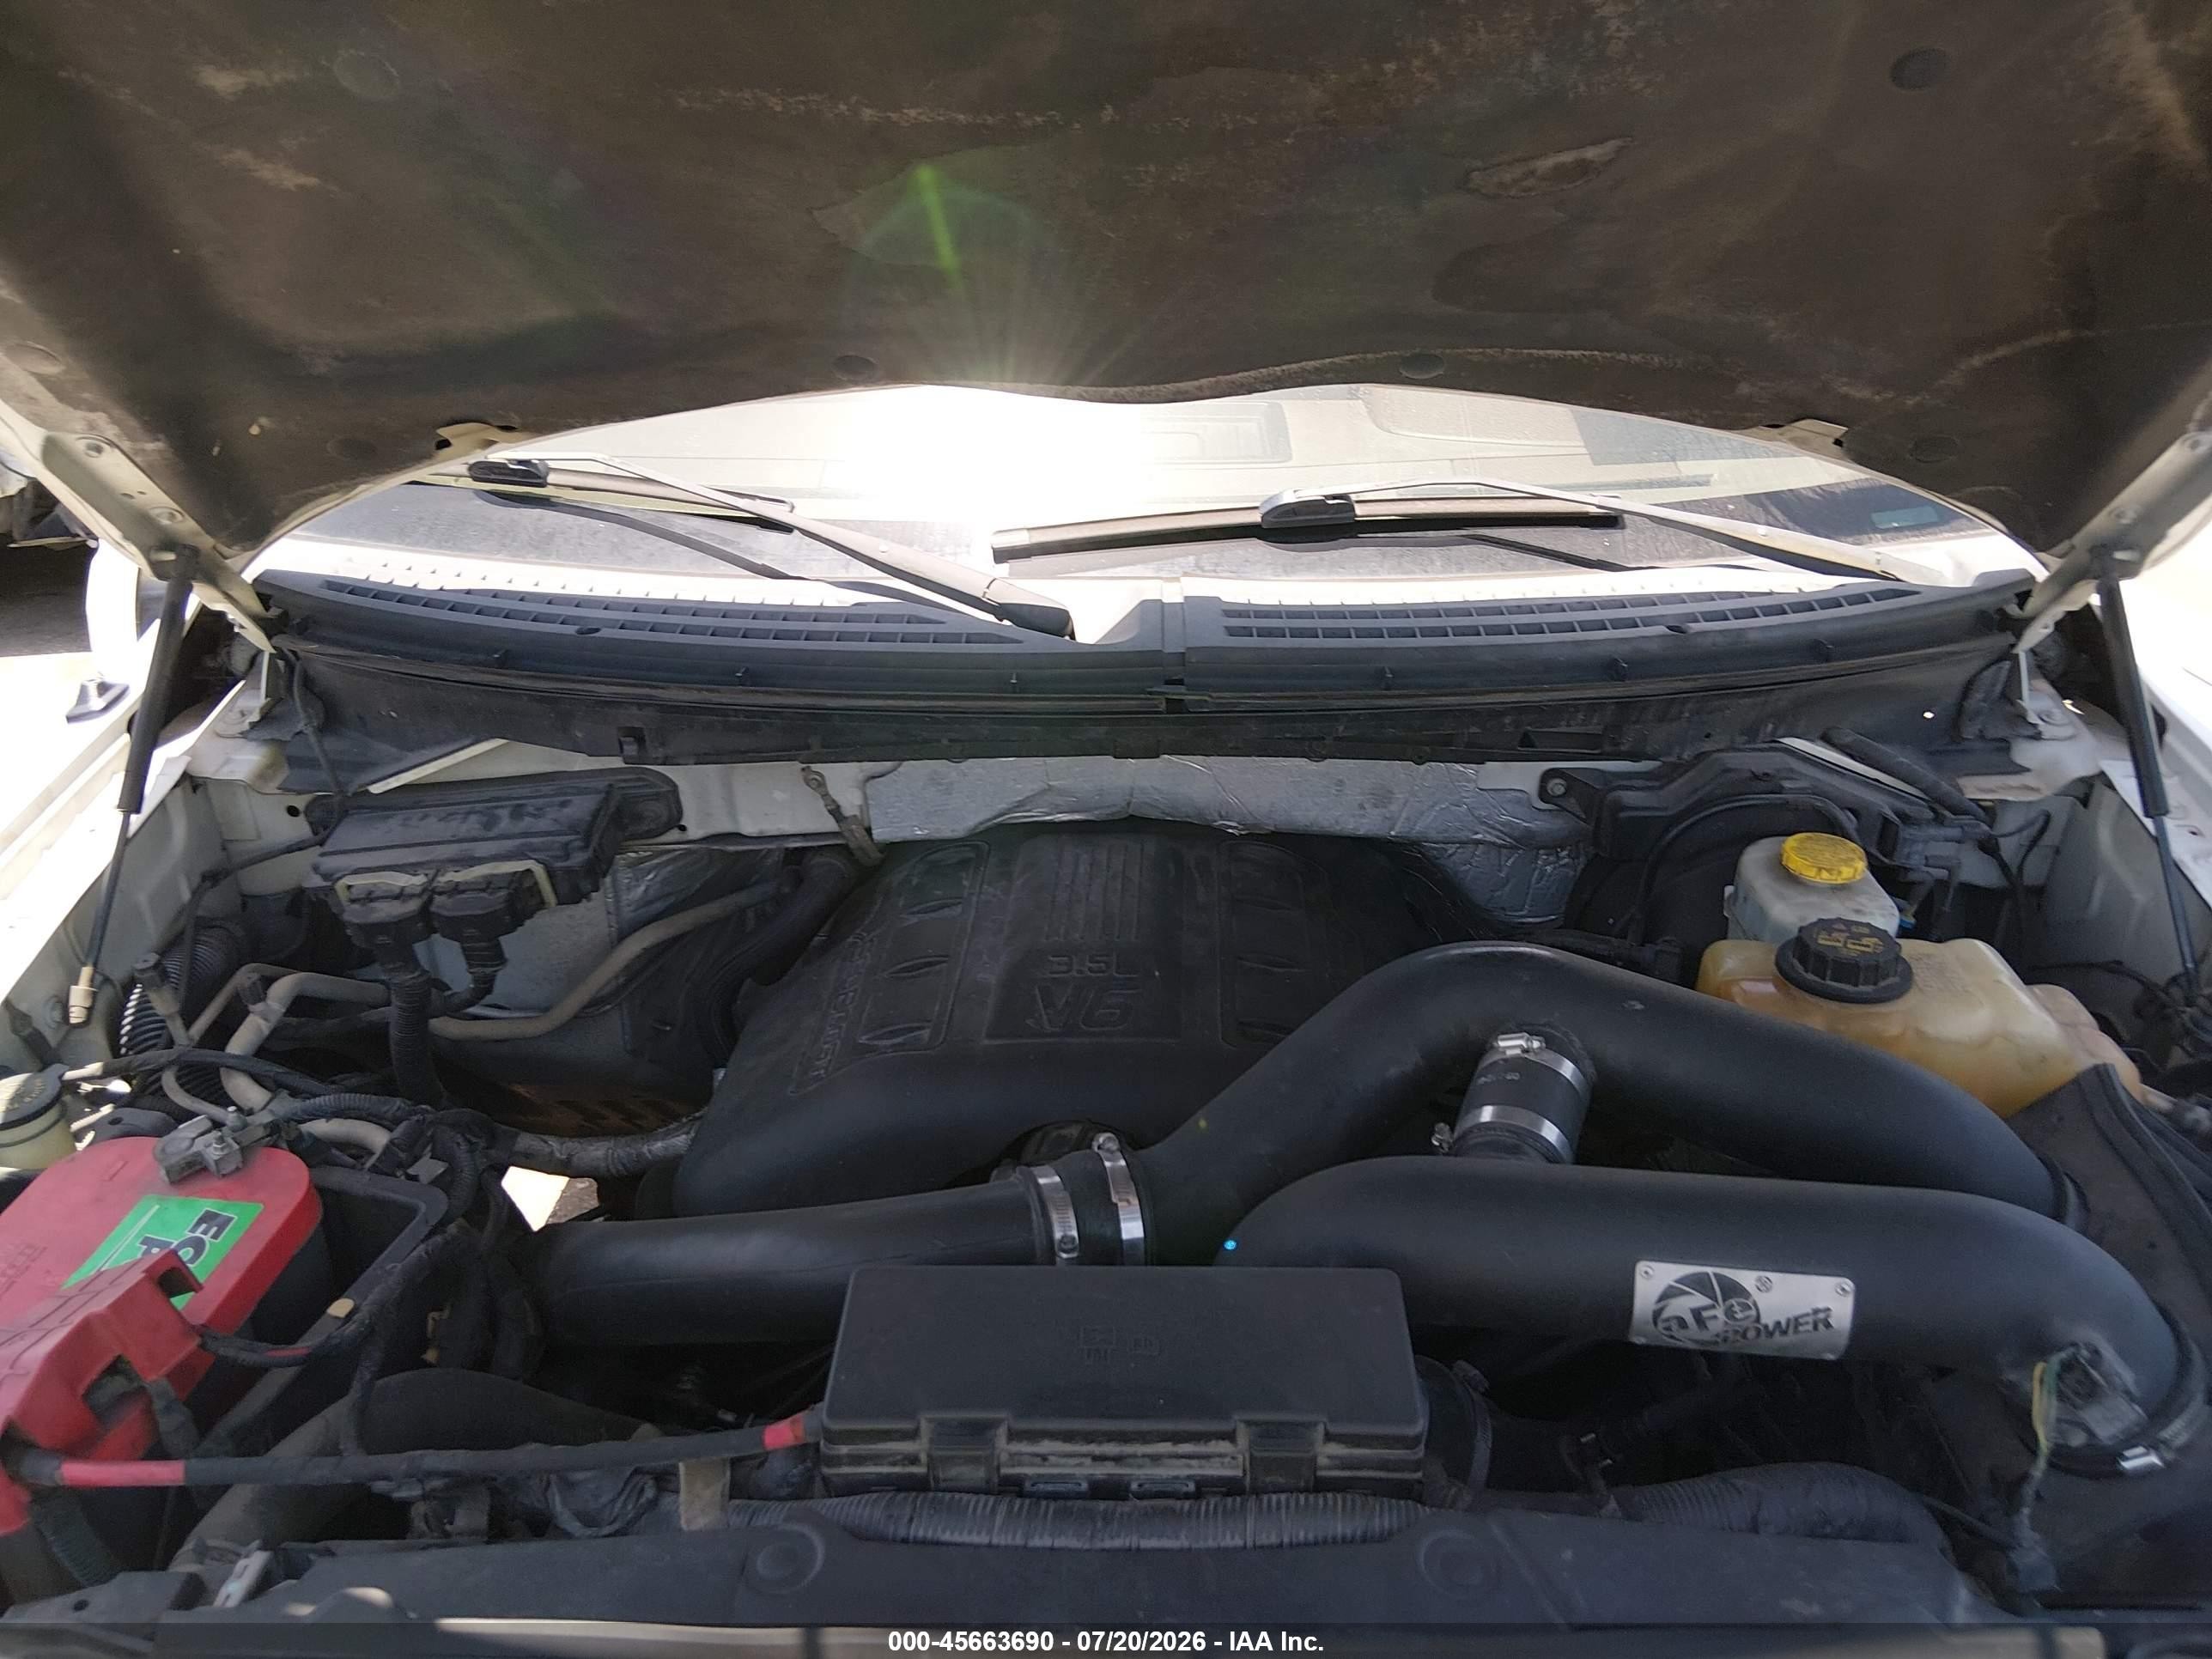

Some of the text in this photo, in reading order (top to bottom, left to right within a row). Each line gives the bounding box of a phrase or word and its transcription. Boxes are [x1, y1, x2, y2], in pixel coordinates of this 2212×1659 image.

[1047, 953, 1139, 977] 3.5L
[1028, 985, 1145, 1031] V6
[1718, 1306, 1835, 1343] POWER
